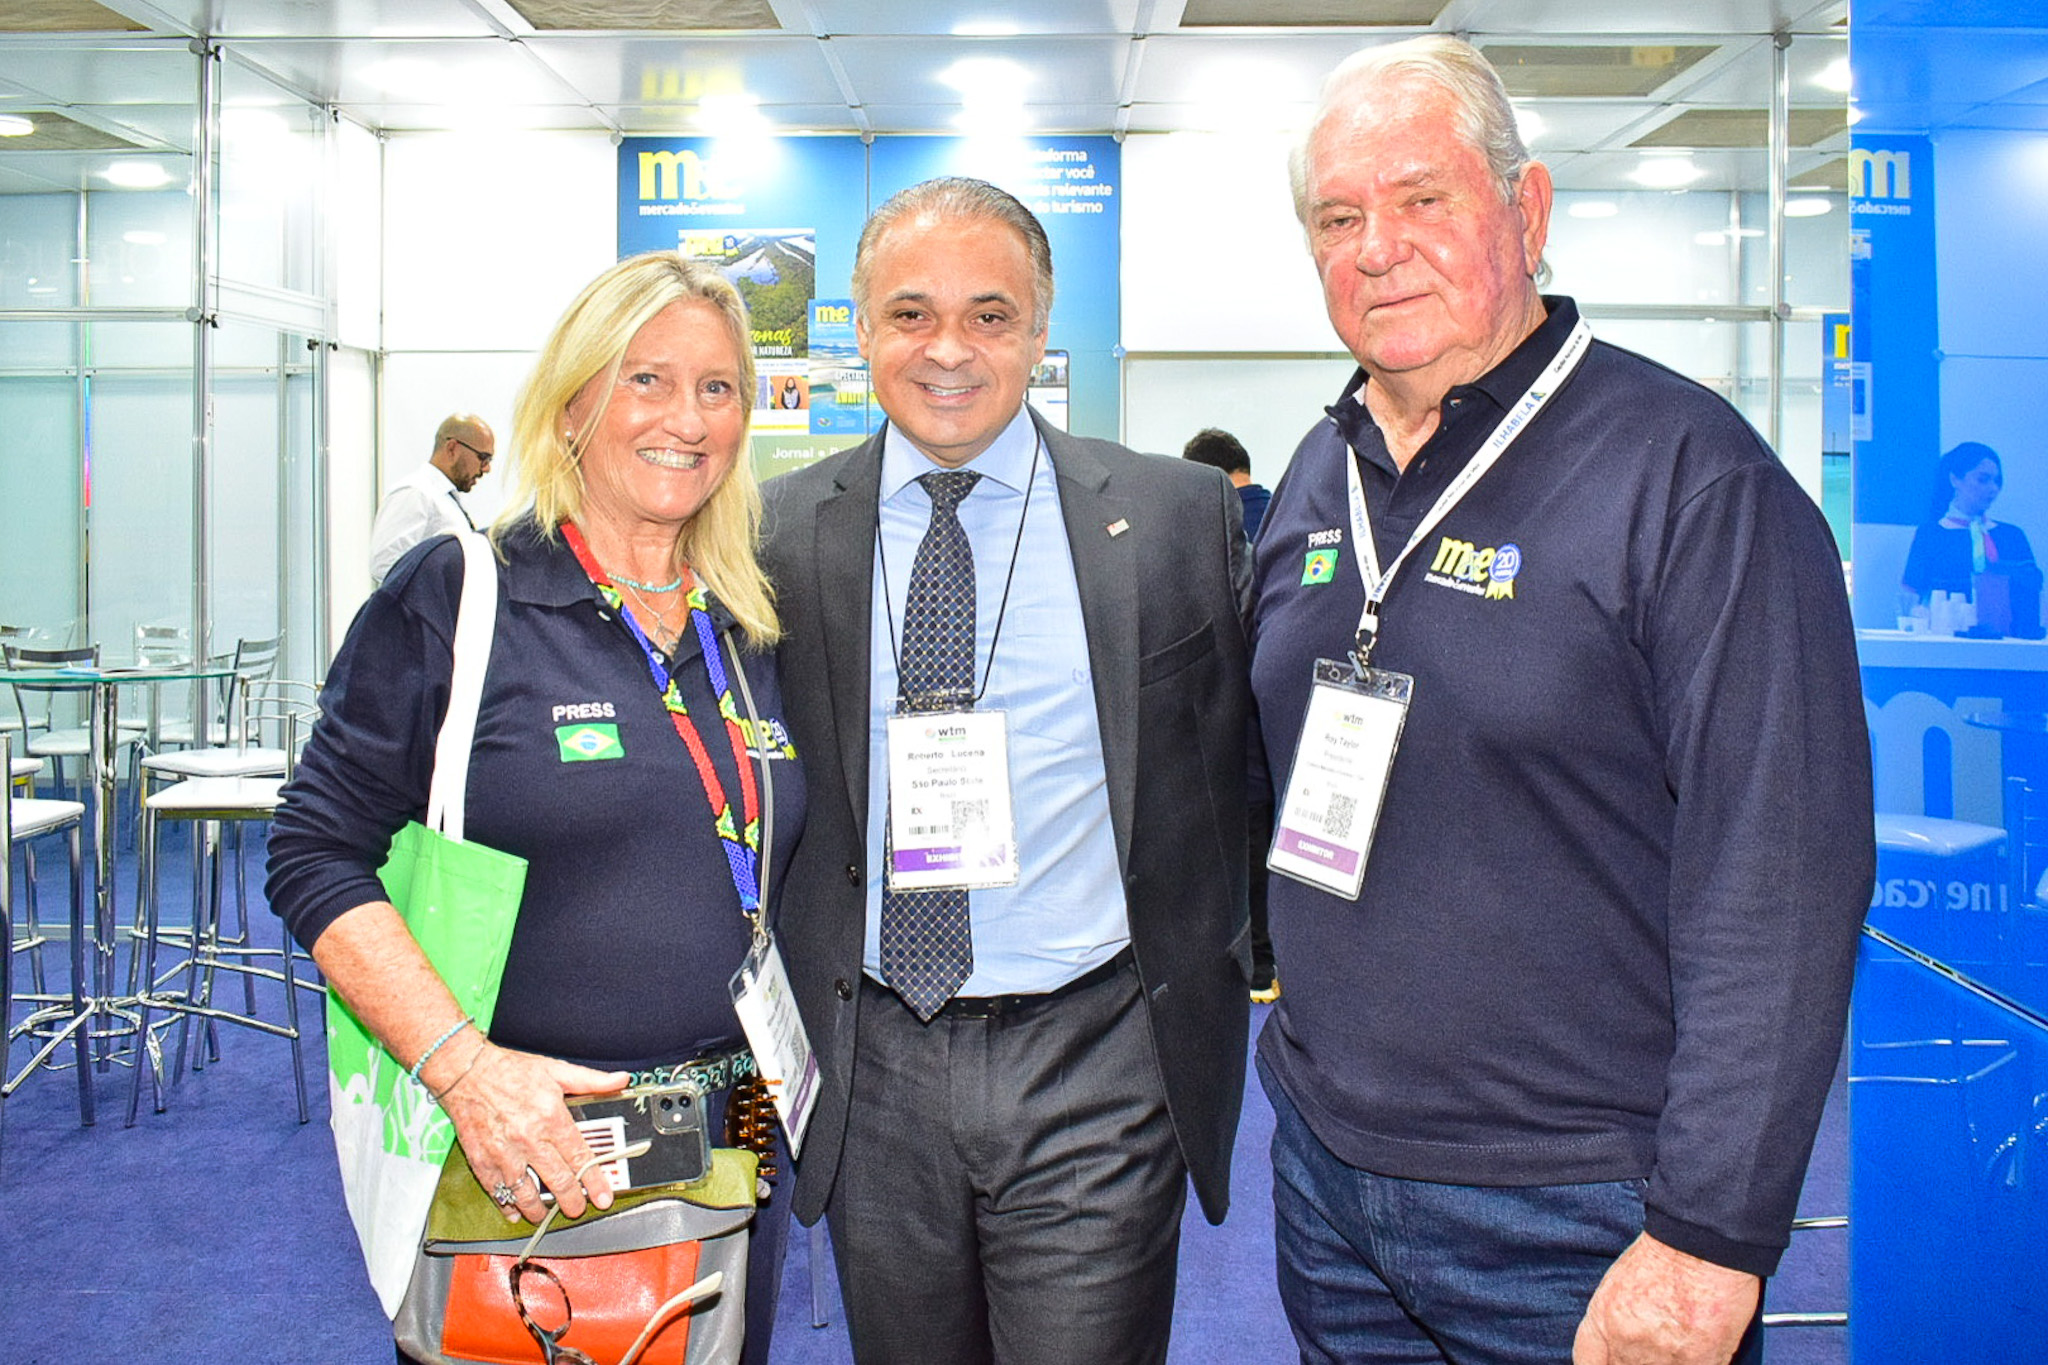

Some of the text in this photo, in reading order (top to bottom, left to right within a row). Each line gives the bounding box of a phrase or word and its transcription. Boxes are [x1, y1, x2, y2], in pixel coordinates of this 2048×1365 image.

[1065, 164, 1095, 179] você
[1052, 182, 1113, 197] relevante
[1052, 199, 1103, 214] turismo
[1493, 401, 1535, 448] ILHABELA
[772, 446, 814, 460] Jornal
[1307, 528, 1343, 549] PRESS
[1495, 551, 1515, 569] 20
[551, 701, 616, 722] PRESS
[1343, 713, 1364, 726] wtm
[938, 726, 967, 737] wtm
[950, 749, 986, 758] Lucena
[931, 778, 958, 788] Paulo
